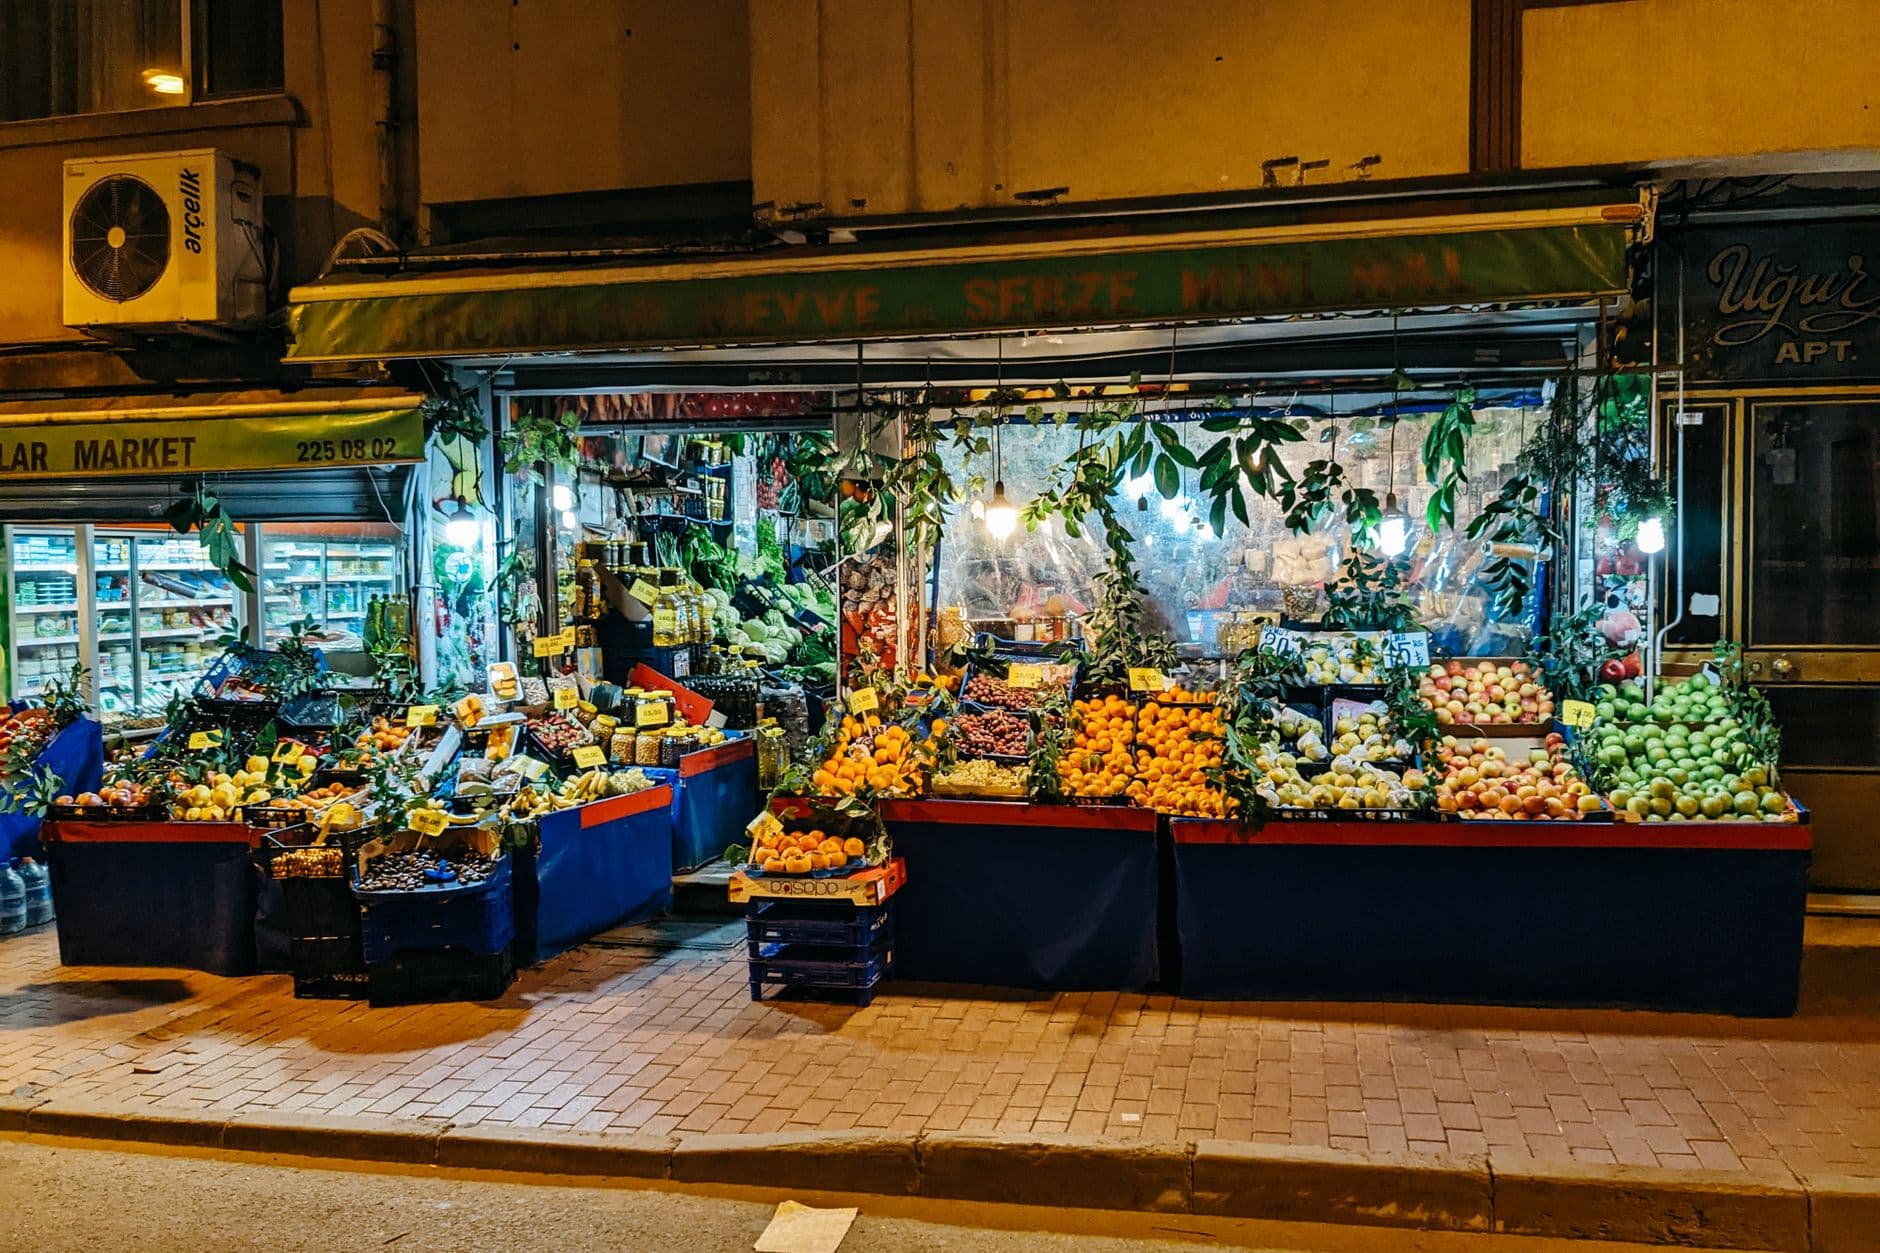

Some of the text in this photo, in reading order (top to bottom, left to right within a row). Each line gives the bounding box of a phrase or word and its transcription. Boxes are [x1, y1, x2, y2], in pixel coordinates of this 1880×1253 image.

[180, 168, 205, 254] arçelik
[1707, 244, 1880, 345] Uğur
[1774, 340, 1857, 364] APT.
[0, 436, 196, 472] LAR MARKET
[296, 436, 397, 462] 225 08 02
